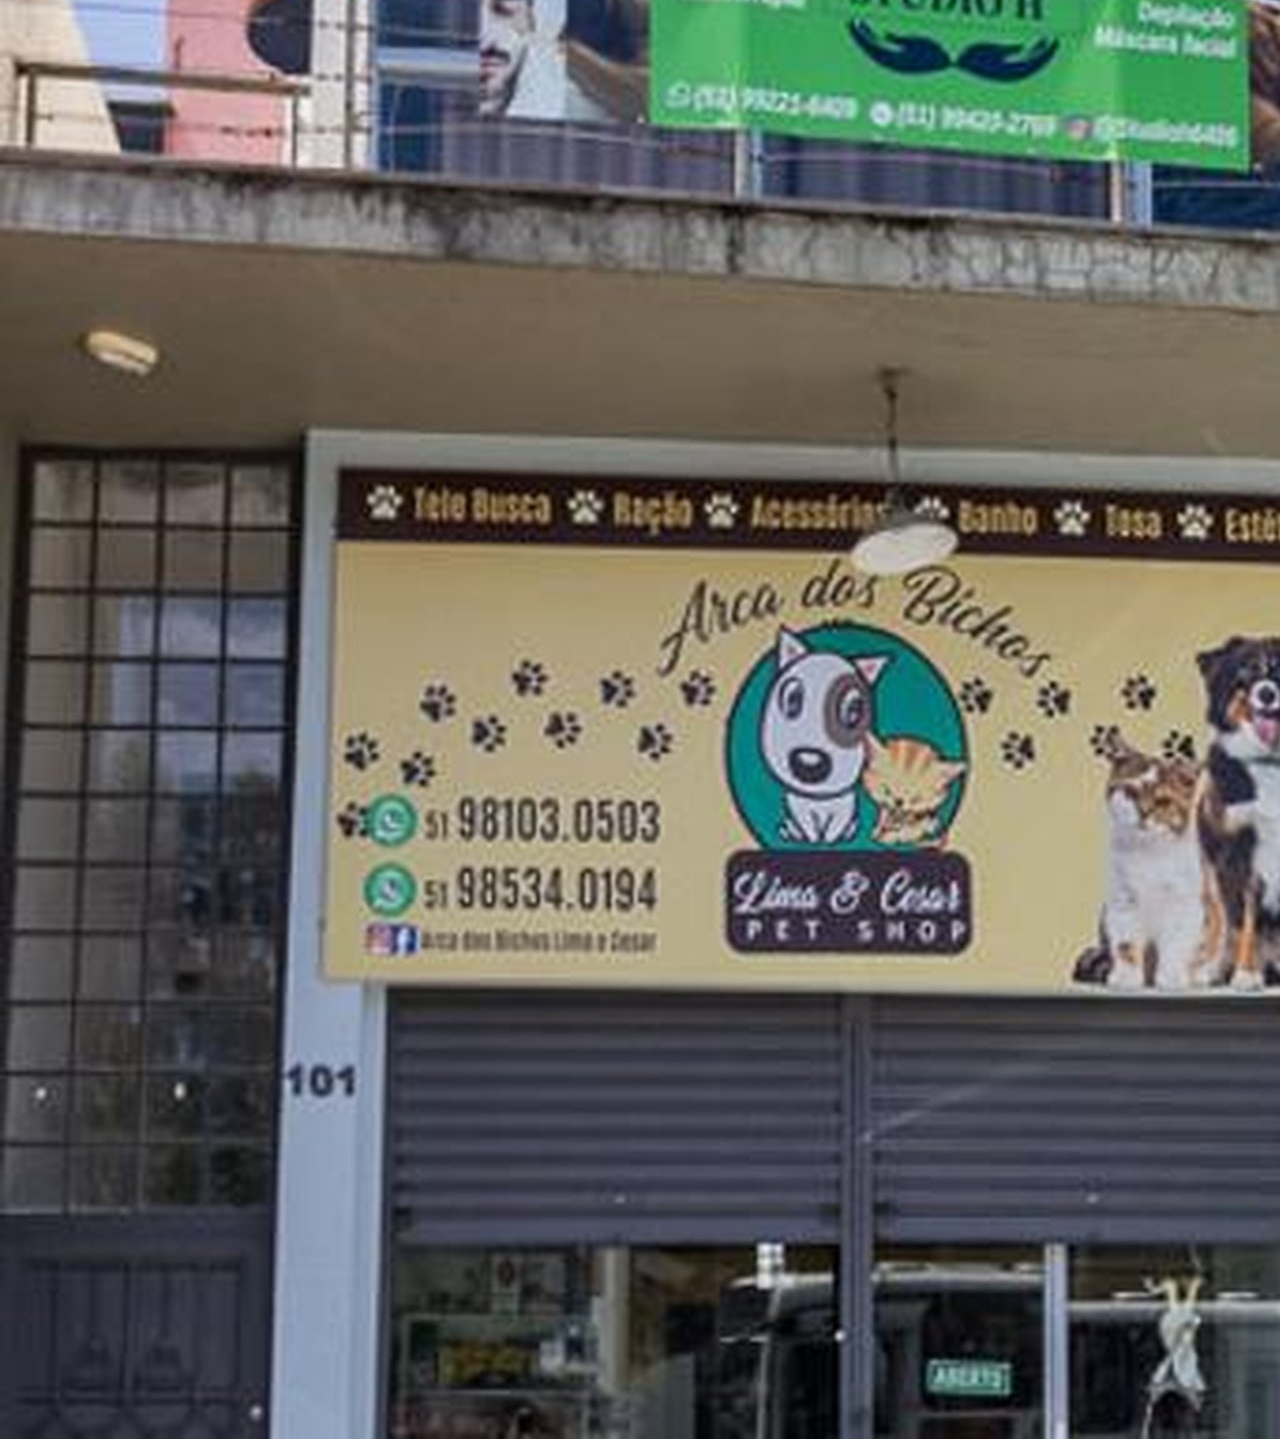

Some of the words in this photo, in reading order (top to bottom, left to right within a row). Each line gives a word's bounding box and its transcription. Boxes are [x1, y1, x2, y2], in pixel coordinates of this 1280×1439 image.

[472, 489, 552, 525] Busca
[613, 492, 692, 536] Ração
[958, 500, 1039, 535] Banho
[1105, 504, 1162, 540] Tosa
[656, 579, 783, 677] Arca
[801, 558, 882, 610] dos
[901, 563, 1052, 679] Bichos
[423, 809, 450, 842] 51
[457, 795, 662, 843] 98103.0503
[423, 879, 450, 910] 51
[456, 865, 659, 912] 98534.0194
[734, 869, 818, 914] Lima
[746, 919, 821, 943] PET
[857, 920, 967, 944] SHOP
[286, 1063, 357, 1098] 101
